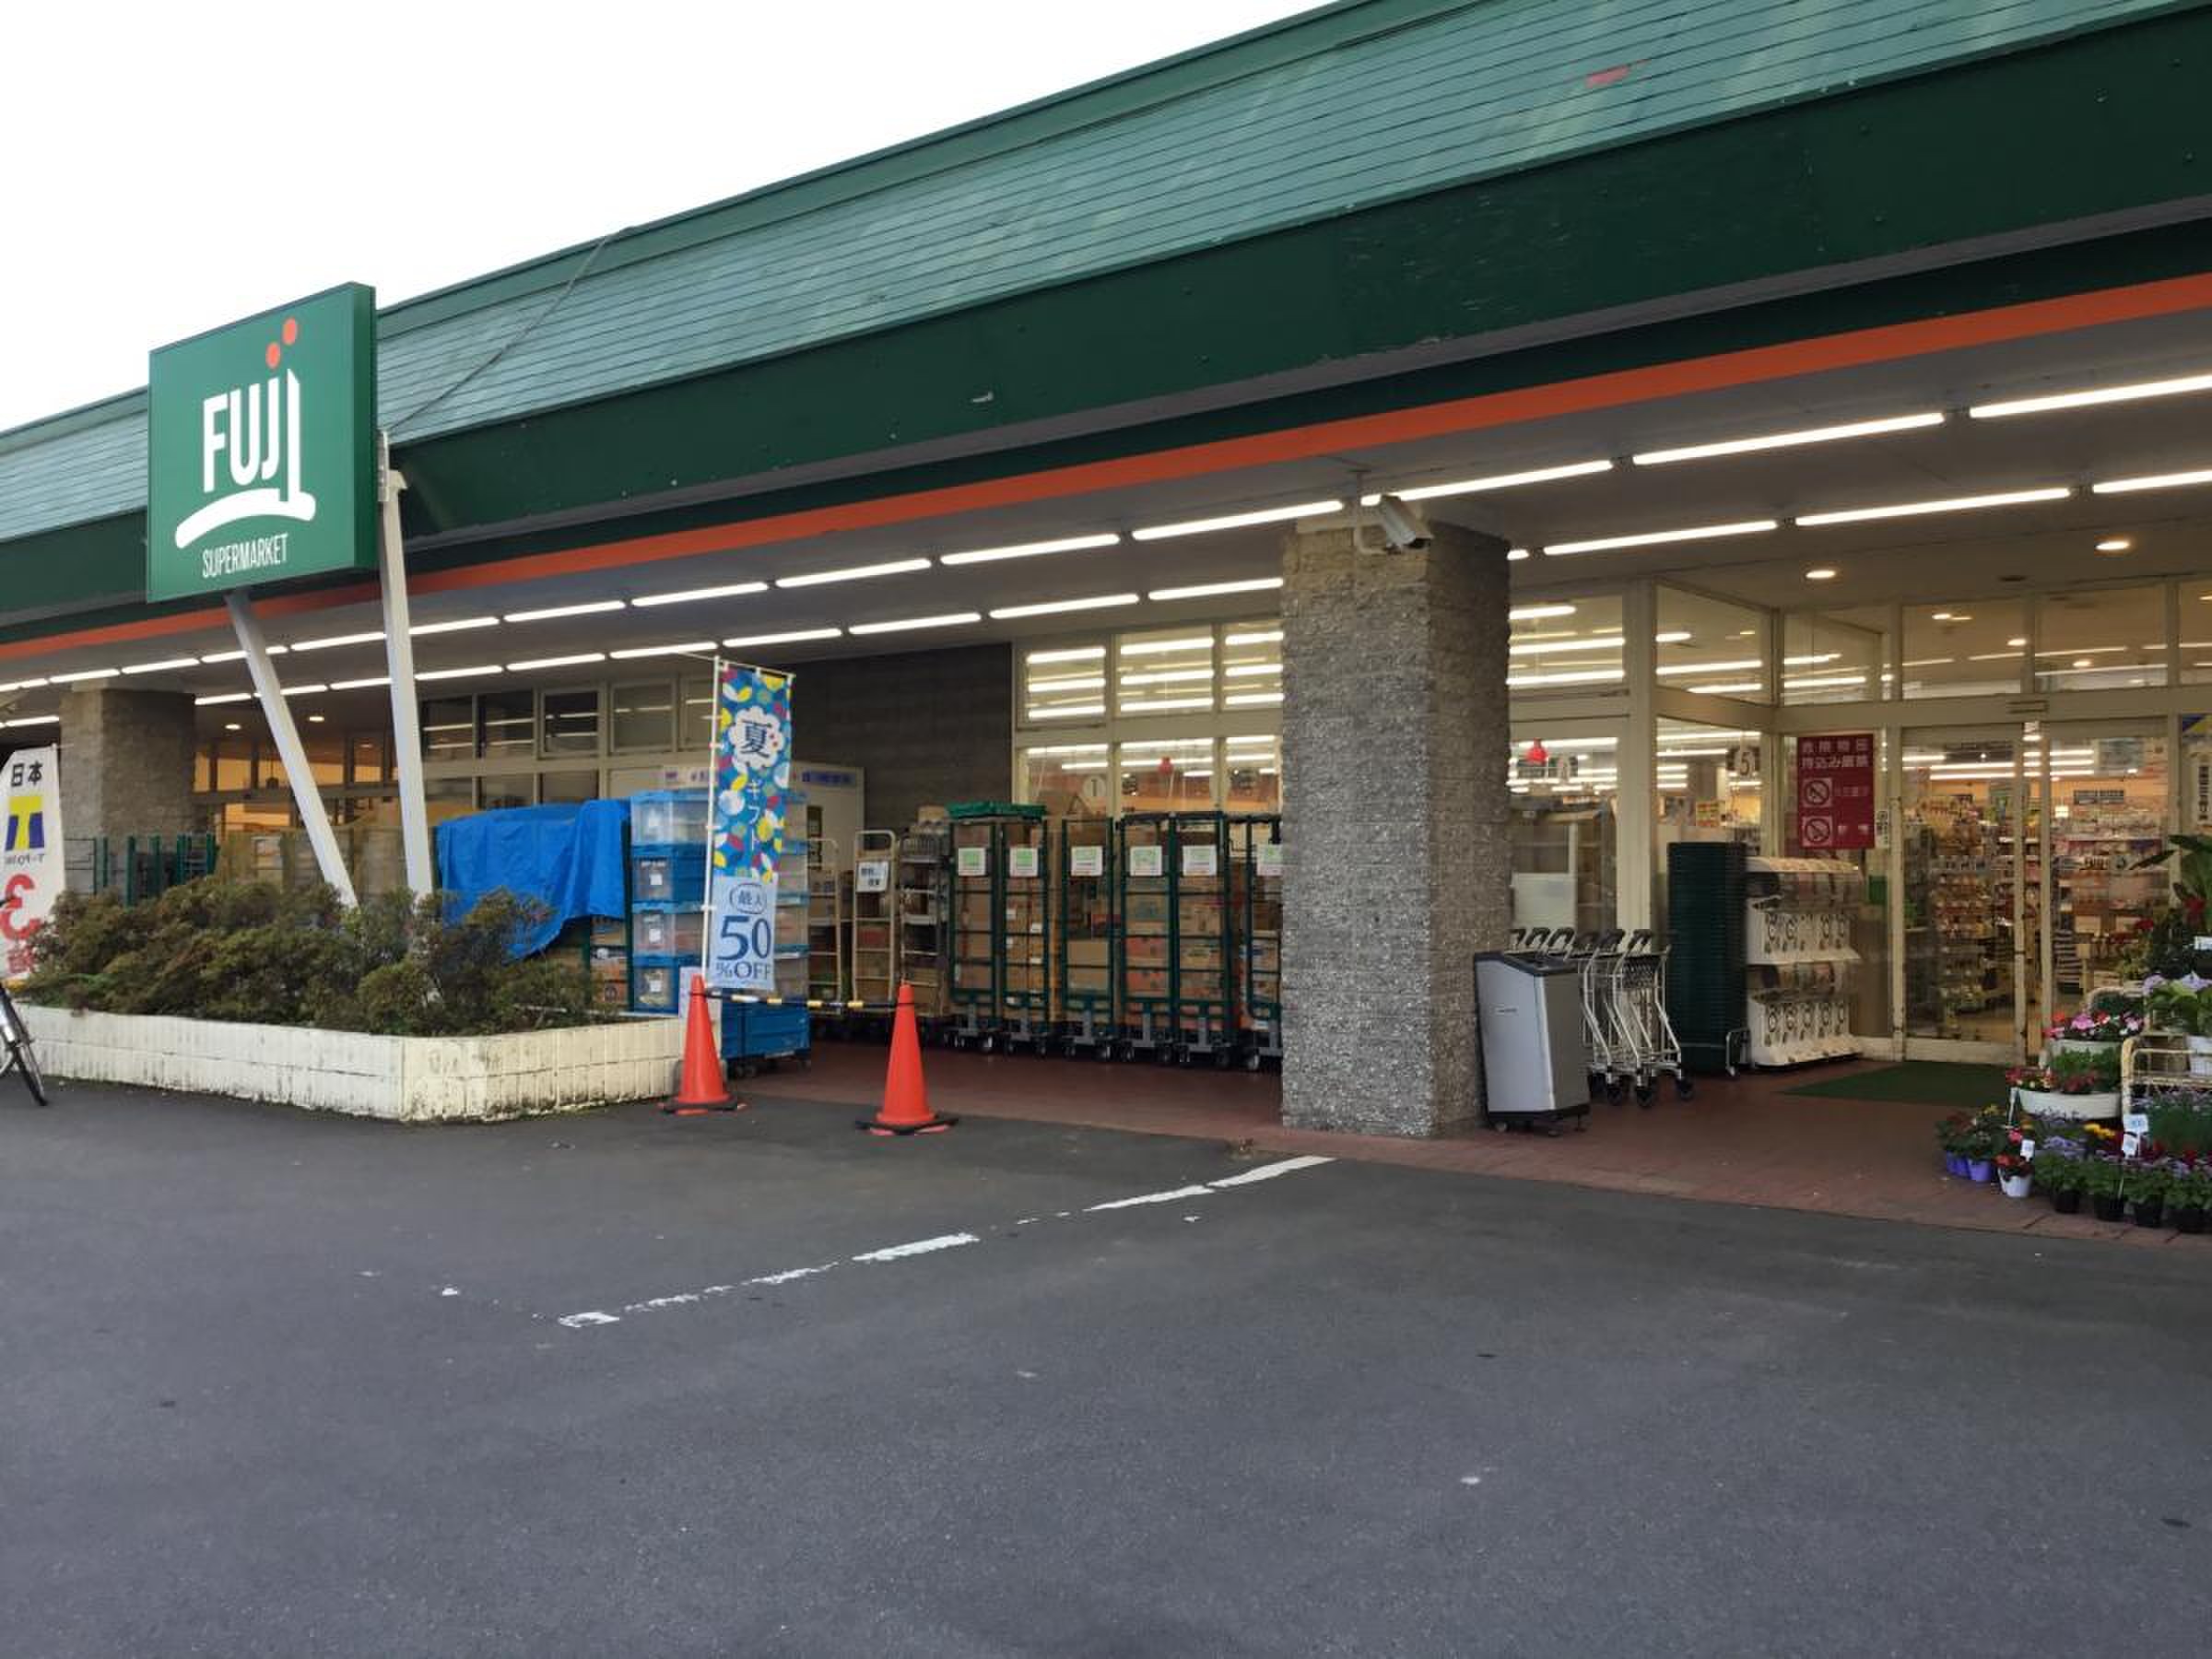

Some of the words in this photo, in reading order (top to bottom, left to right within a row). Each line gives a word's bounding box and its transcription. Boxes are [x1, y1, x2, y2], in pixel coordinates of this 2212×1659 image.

[200, 318, 304, 505] FUJI
[202, 532, 288, 579] SUPERMARKET
[740, 719, 771, 759] 夏
[717, 914, 771, 960] 50
[715, 961, 772, 980] %OFF
